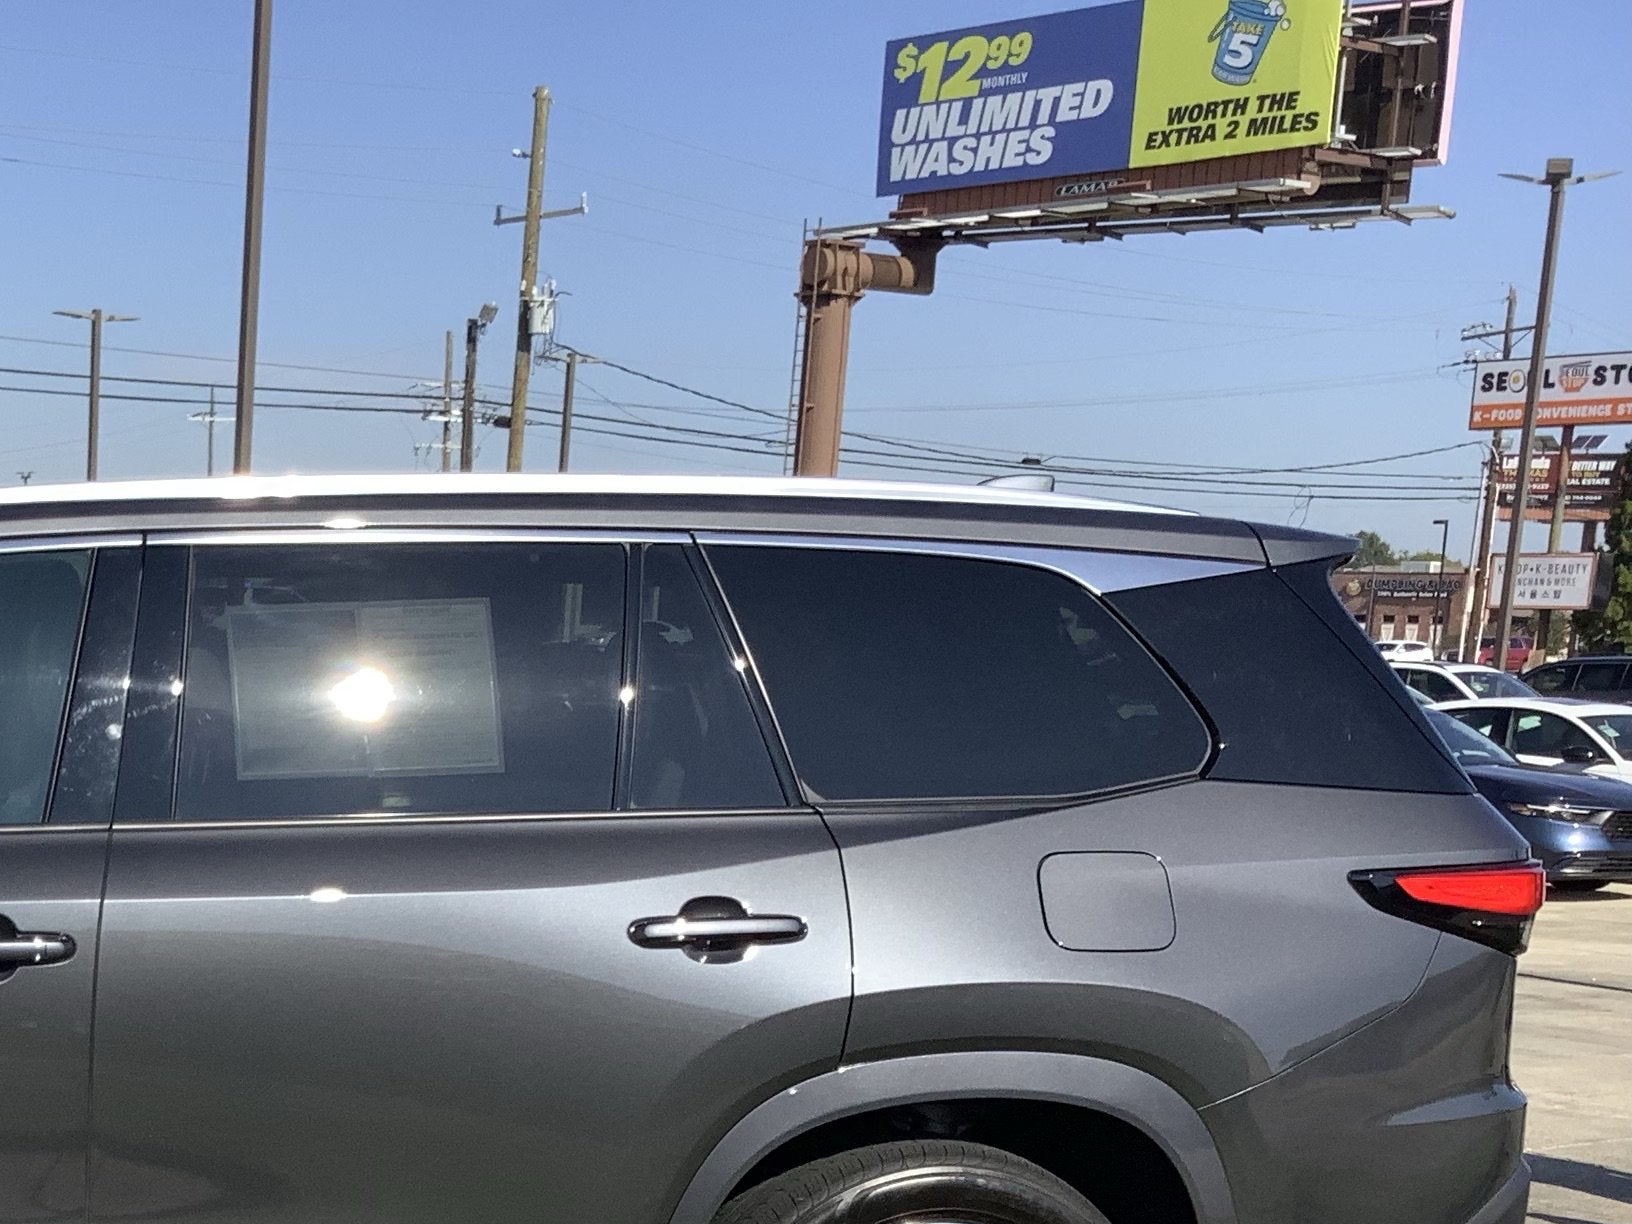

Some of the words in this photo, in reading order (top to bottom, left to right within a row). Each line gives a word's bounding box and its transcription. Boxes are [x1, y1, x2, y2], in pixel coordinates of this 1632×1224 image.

[1231, 21, 1265, 35] TAKE
[1223, 33, 1260, 68] 5
[982, 72, 1028, 90] MONTHLY
[890, 78, 1114, 146] UNLIMITED
[1167, 97, 1250, 126] WORTH
[1256, 91, 1301, 114] THE
[1144, 125, 1217, 151] EXTRA
[1223, 120, 1241, 140] 2
[1245, 112, 1320, 137] MILES
[889, 126, 1057, 183] WASHES
[1472, 408, 1522, 422] K-FOOD
[1536, 403, 1612, 420] ONVENIENCE
[1364, 579, 1426, 591] DUMPLING
